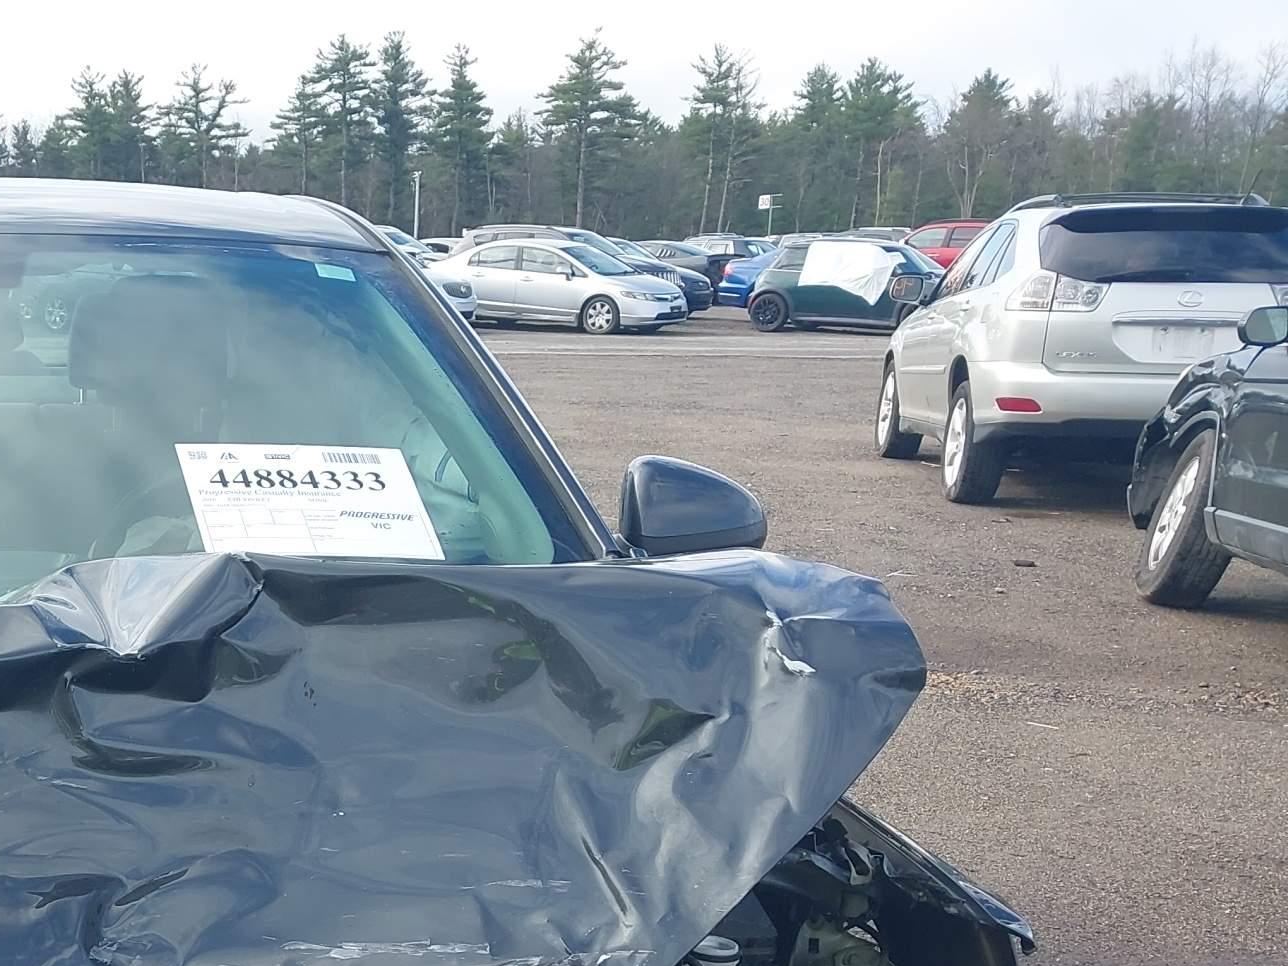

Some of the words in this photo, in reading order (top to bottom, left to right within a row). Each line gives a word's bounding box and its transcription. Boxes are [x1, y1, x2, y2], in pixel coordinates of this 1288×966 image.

[209, 468, 386, 491] 44884333
[339, 510, 414, 521] PROGRESSIVE
[370, 522, 392, 530] VIC
